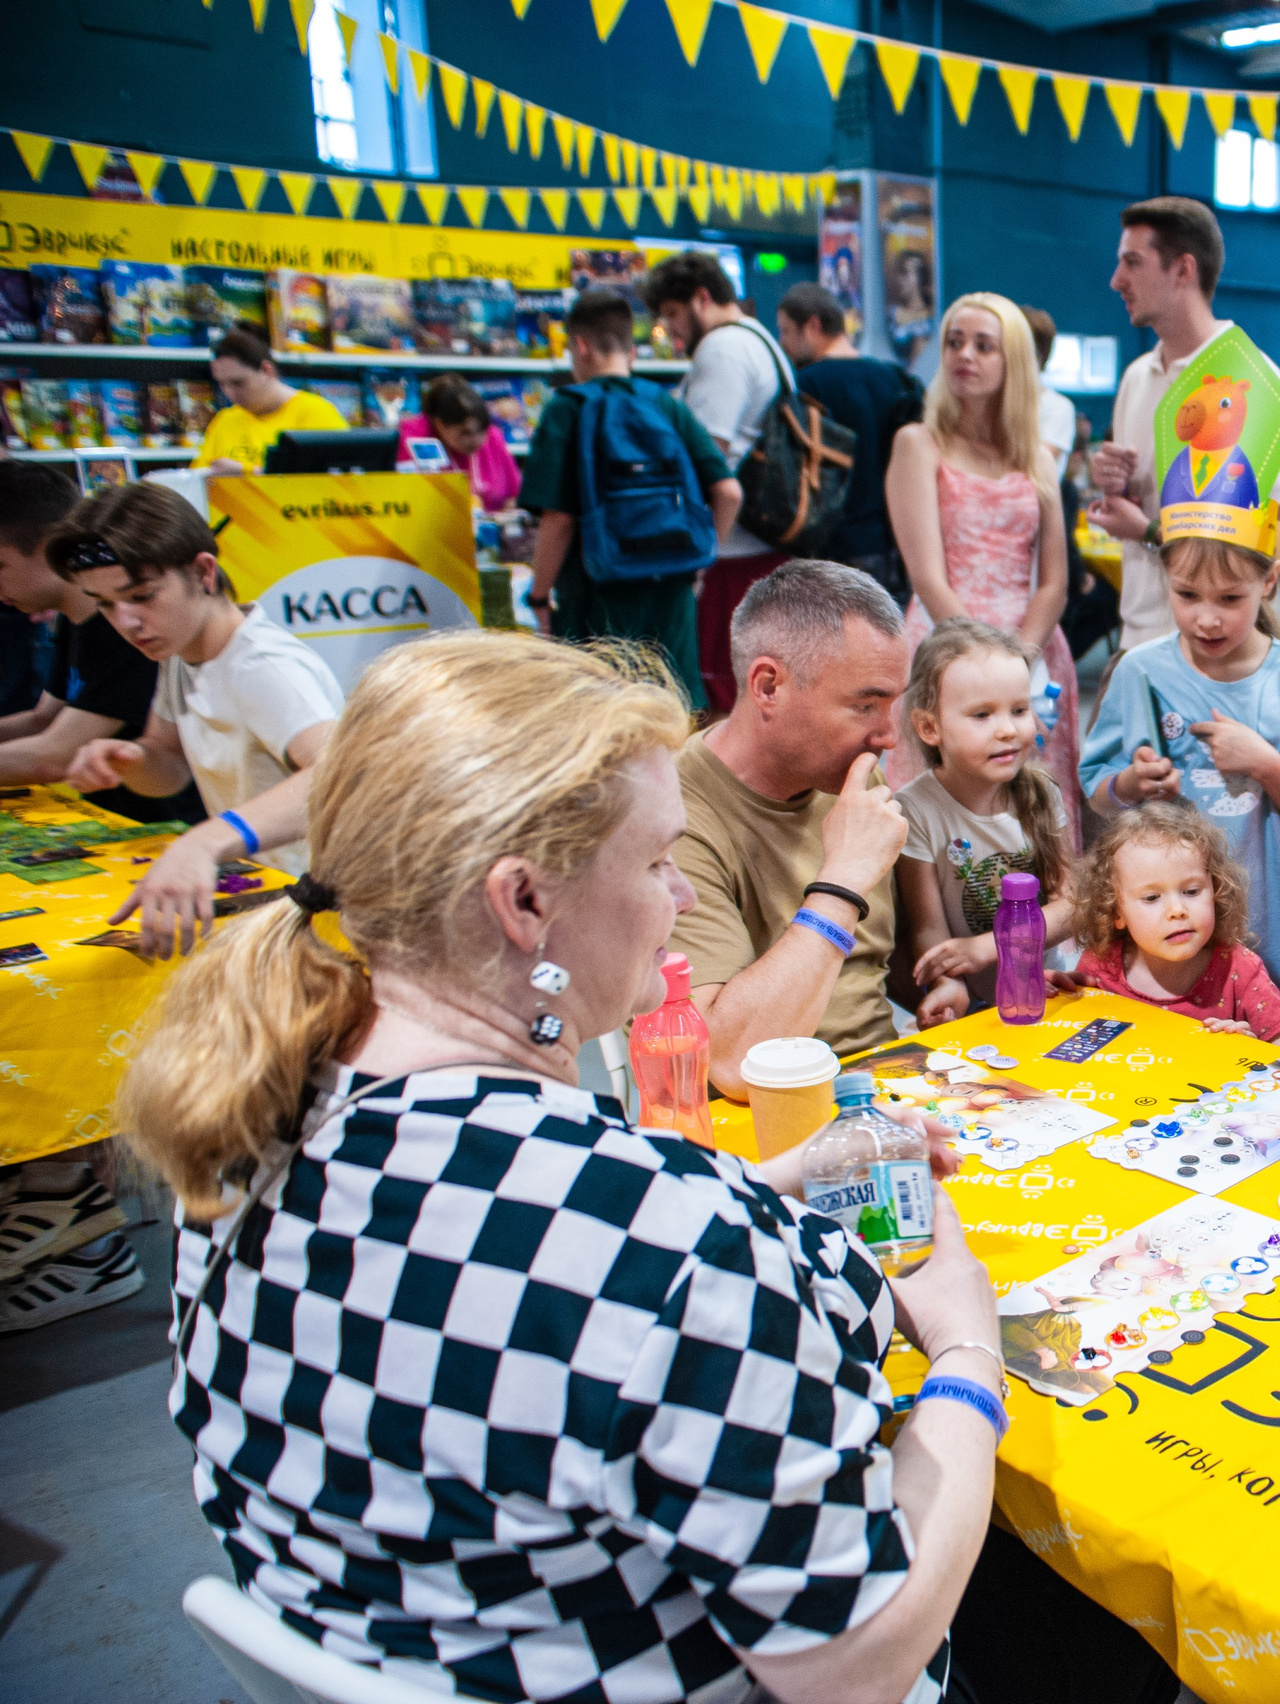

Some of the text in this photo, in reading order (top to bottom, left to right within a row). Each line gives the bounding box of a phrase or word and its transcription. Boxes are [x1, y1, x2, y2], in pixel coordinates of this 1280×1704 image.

[170, 237, 375, 273] НАСТОЛЬНЫЕ ИГРЫ
[281, 500, 410, 522] evrikus.ru
[1217, 525, 1237, 534] дел
[282, 584, 430, 624] КАССА
[826, 925, 855, 951] ЕСТИВАЛЬ
[1145, 1430, 1217, 1481] ИГРЫ,
